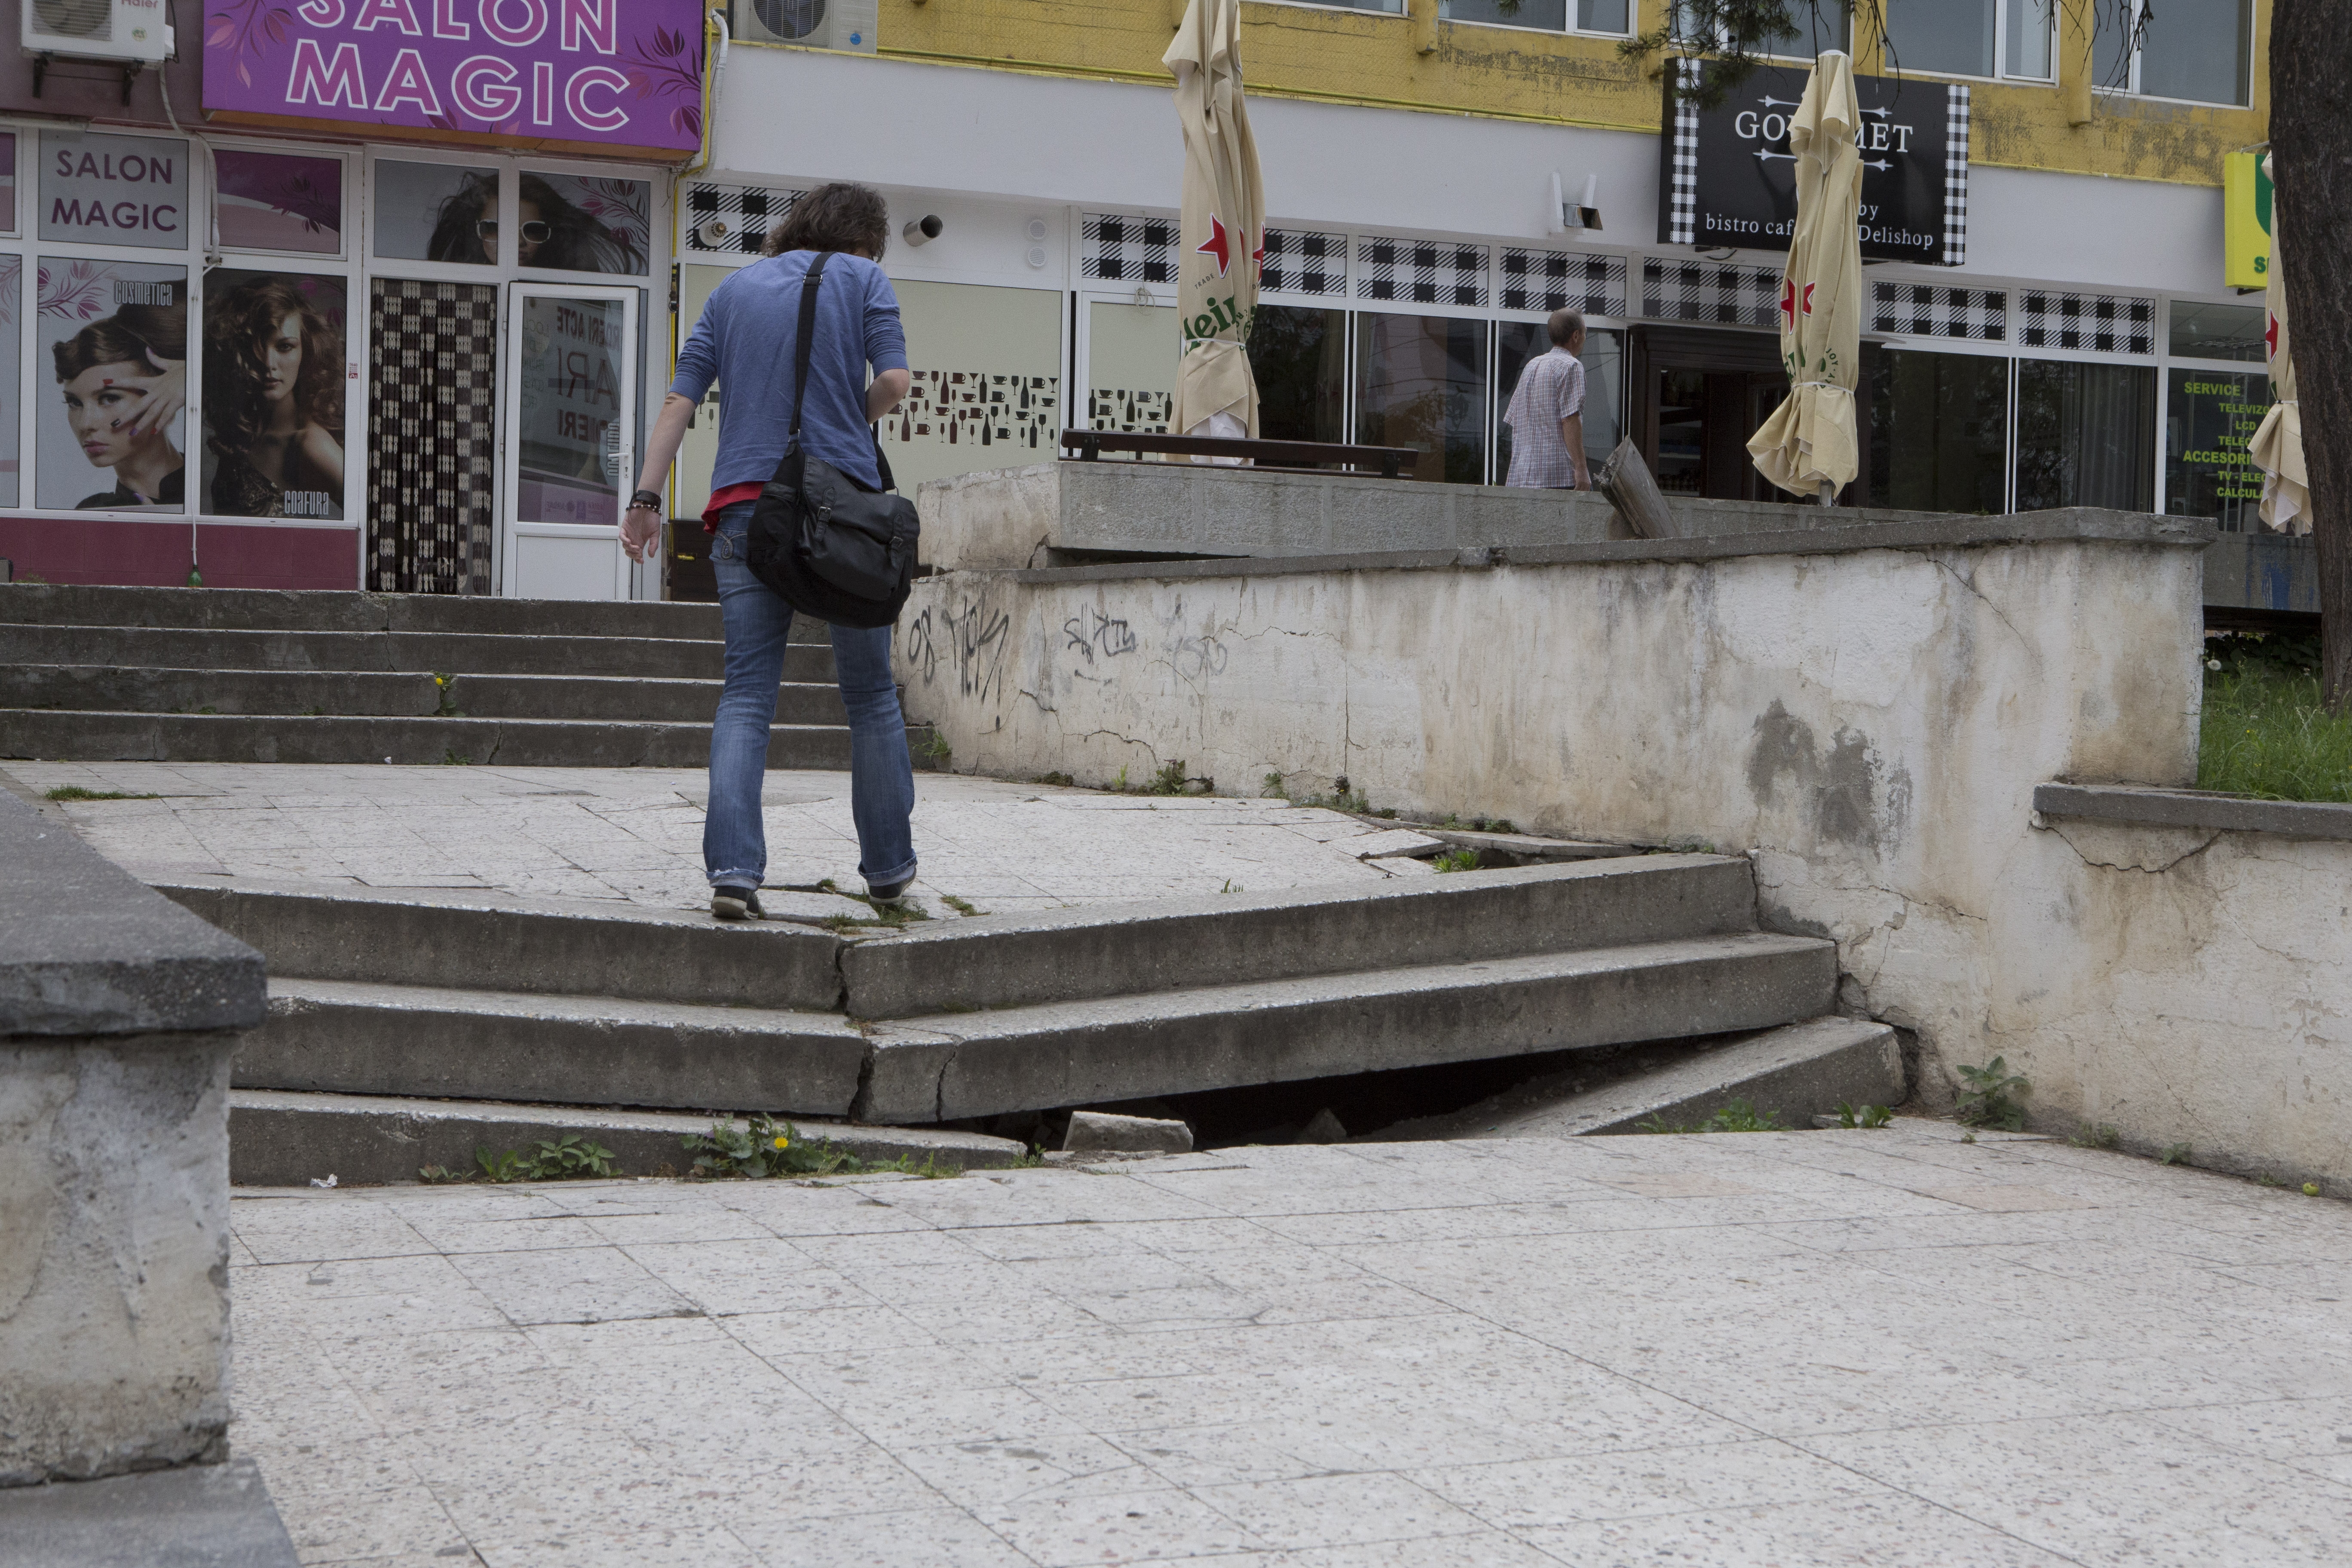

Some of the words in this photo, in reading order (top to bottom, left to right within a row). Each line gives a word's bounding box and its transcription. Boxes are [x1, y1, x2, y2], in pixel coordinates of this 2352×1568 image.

[285, 39, 631, 132] MAGIC
[56, 150, 172, 184] SALON
[51, 198, 178, 232] MAGIC
[1859, 199, 1879, 221] by
[1705, 213, 1759, 233] bistro
[1858, 225, 1933, 250] Delishop
[1194, 273, 1215, 289] TRADE
[2184, 382, 2241, 397] SERVICE
[2236, 421, 2256, 431] LCD
[2217, 471, 2233, 481] TV
